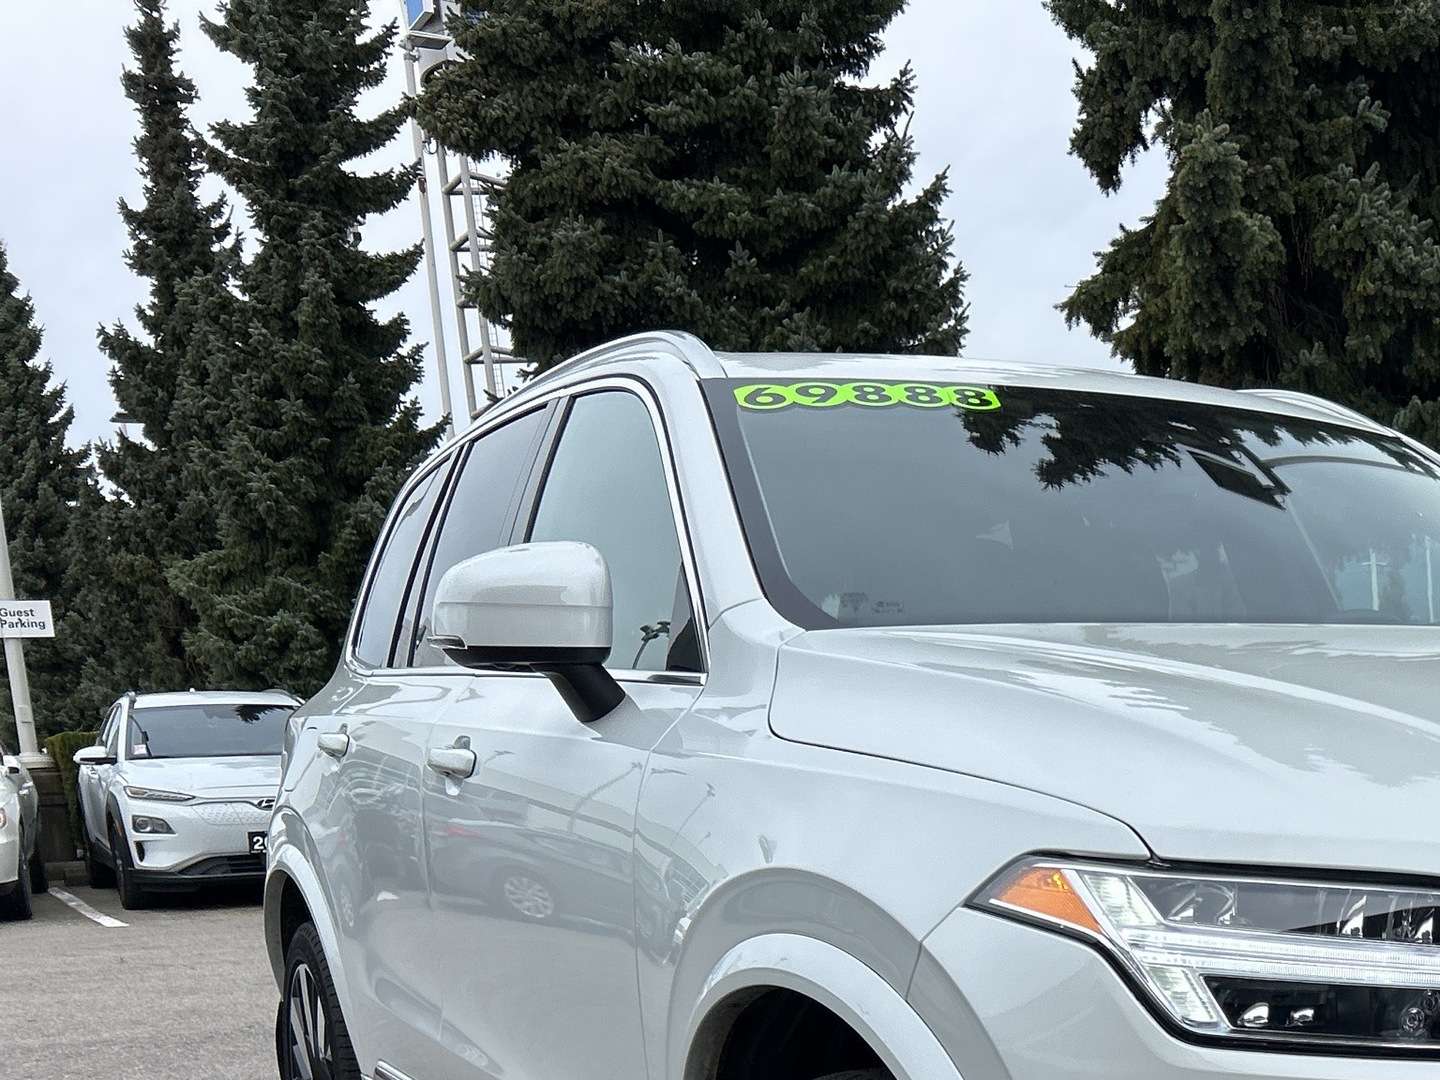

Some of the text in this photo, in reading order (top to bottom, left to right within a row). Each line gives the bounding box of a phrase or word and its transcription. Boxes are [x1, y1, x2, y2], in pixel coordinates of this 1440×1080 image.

[742, 382, 995, 409] 69888
[0, 608, 35, 617] Guest
[0, 619, 45, 630] Parking
